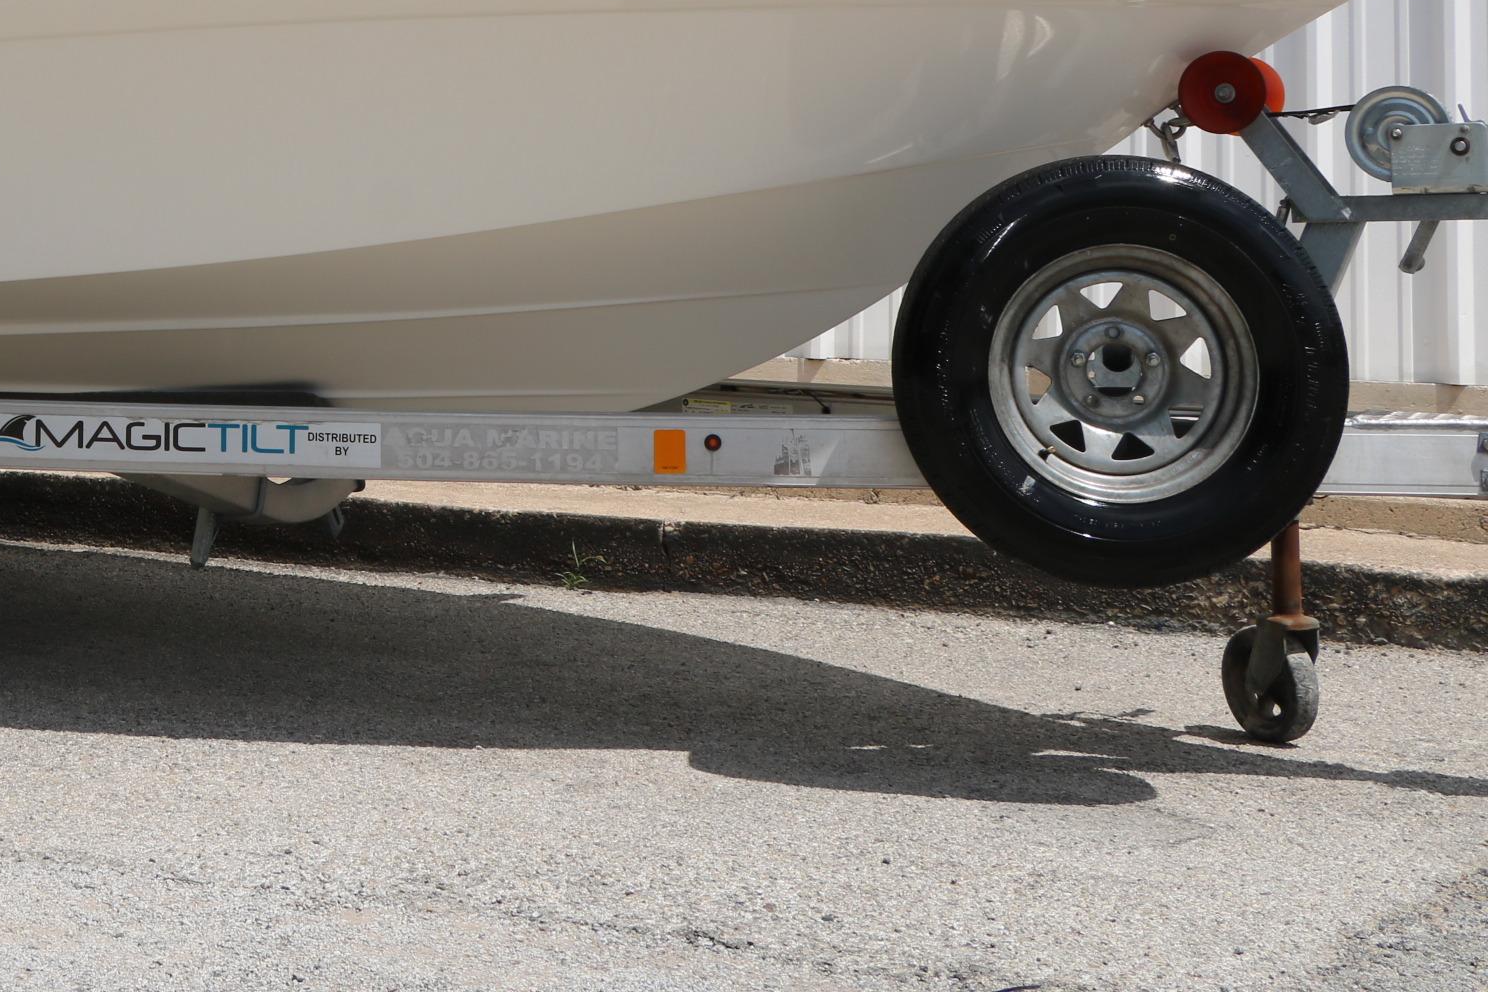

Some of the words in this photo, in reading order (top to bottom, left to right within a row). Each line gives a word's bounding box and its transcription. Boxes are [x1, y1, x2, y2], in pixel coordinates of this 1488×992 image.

[35, 418, 310, 455] MAGICTILT
[307, 431, 378, 445] DISTRIBUTED
[486, 427, 617, 451] MARINE
[334, 446, 350, 457] BY
